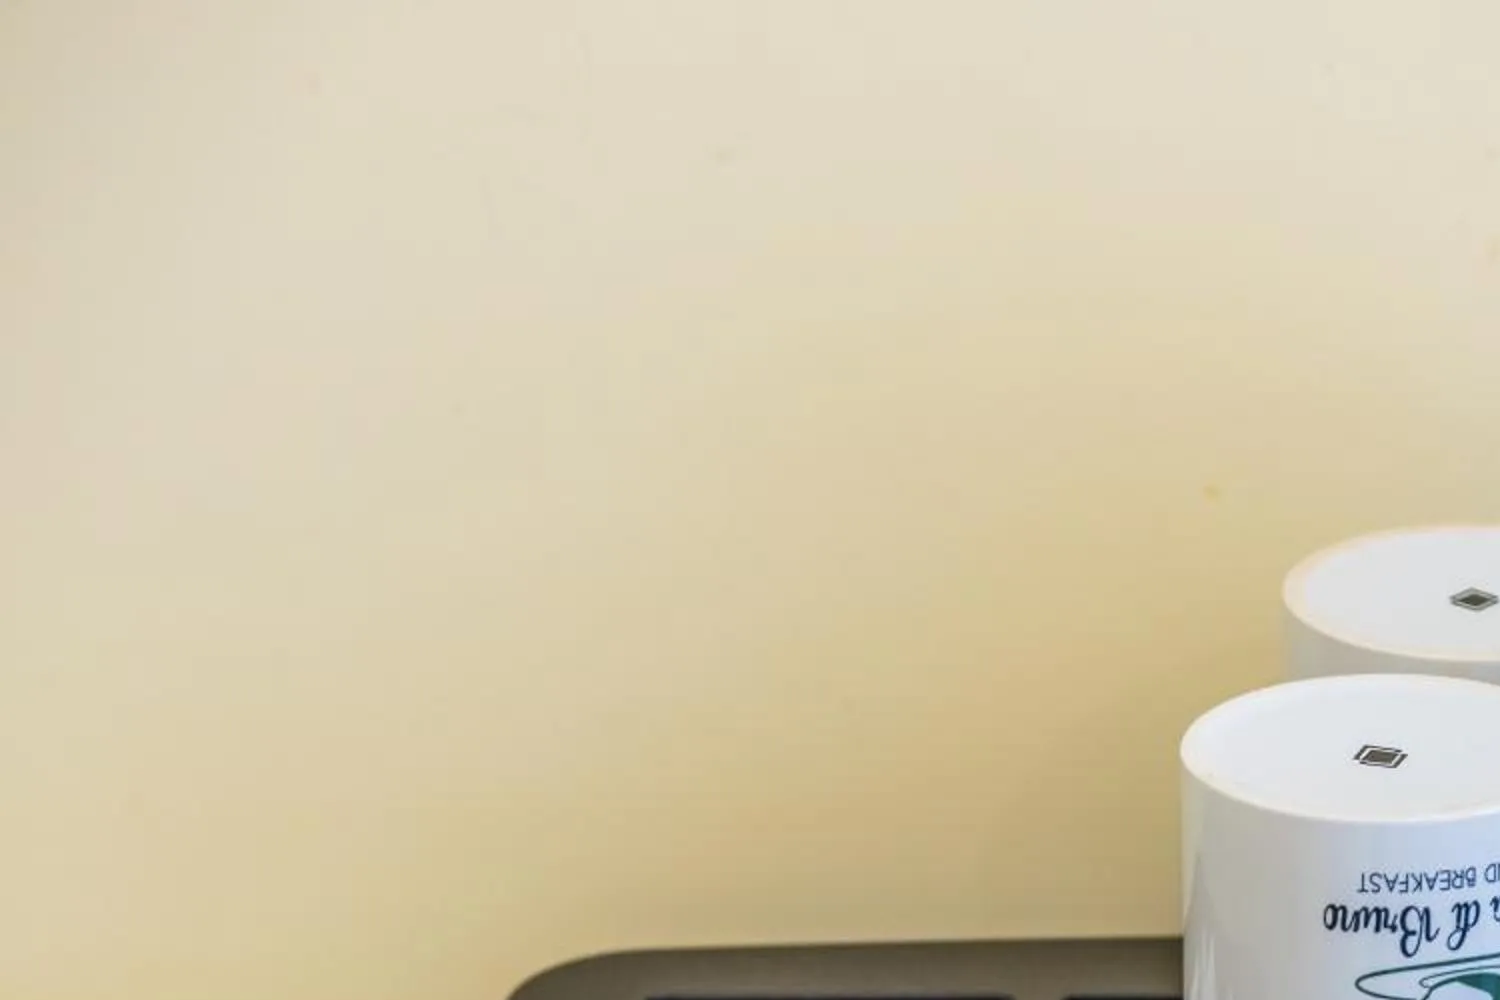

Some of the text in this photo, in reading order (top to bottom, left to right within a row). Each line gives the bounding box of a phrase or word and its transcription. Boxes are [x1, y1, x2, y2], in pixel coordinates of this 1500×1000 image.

[1357, 866, 1478, 894] BREAKFAST
[1323, 902, 1440, 958] Bruno
[1447, 899, 1481, 951] di
